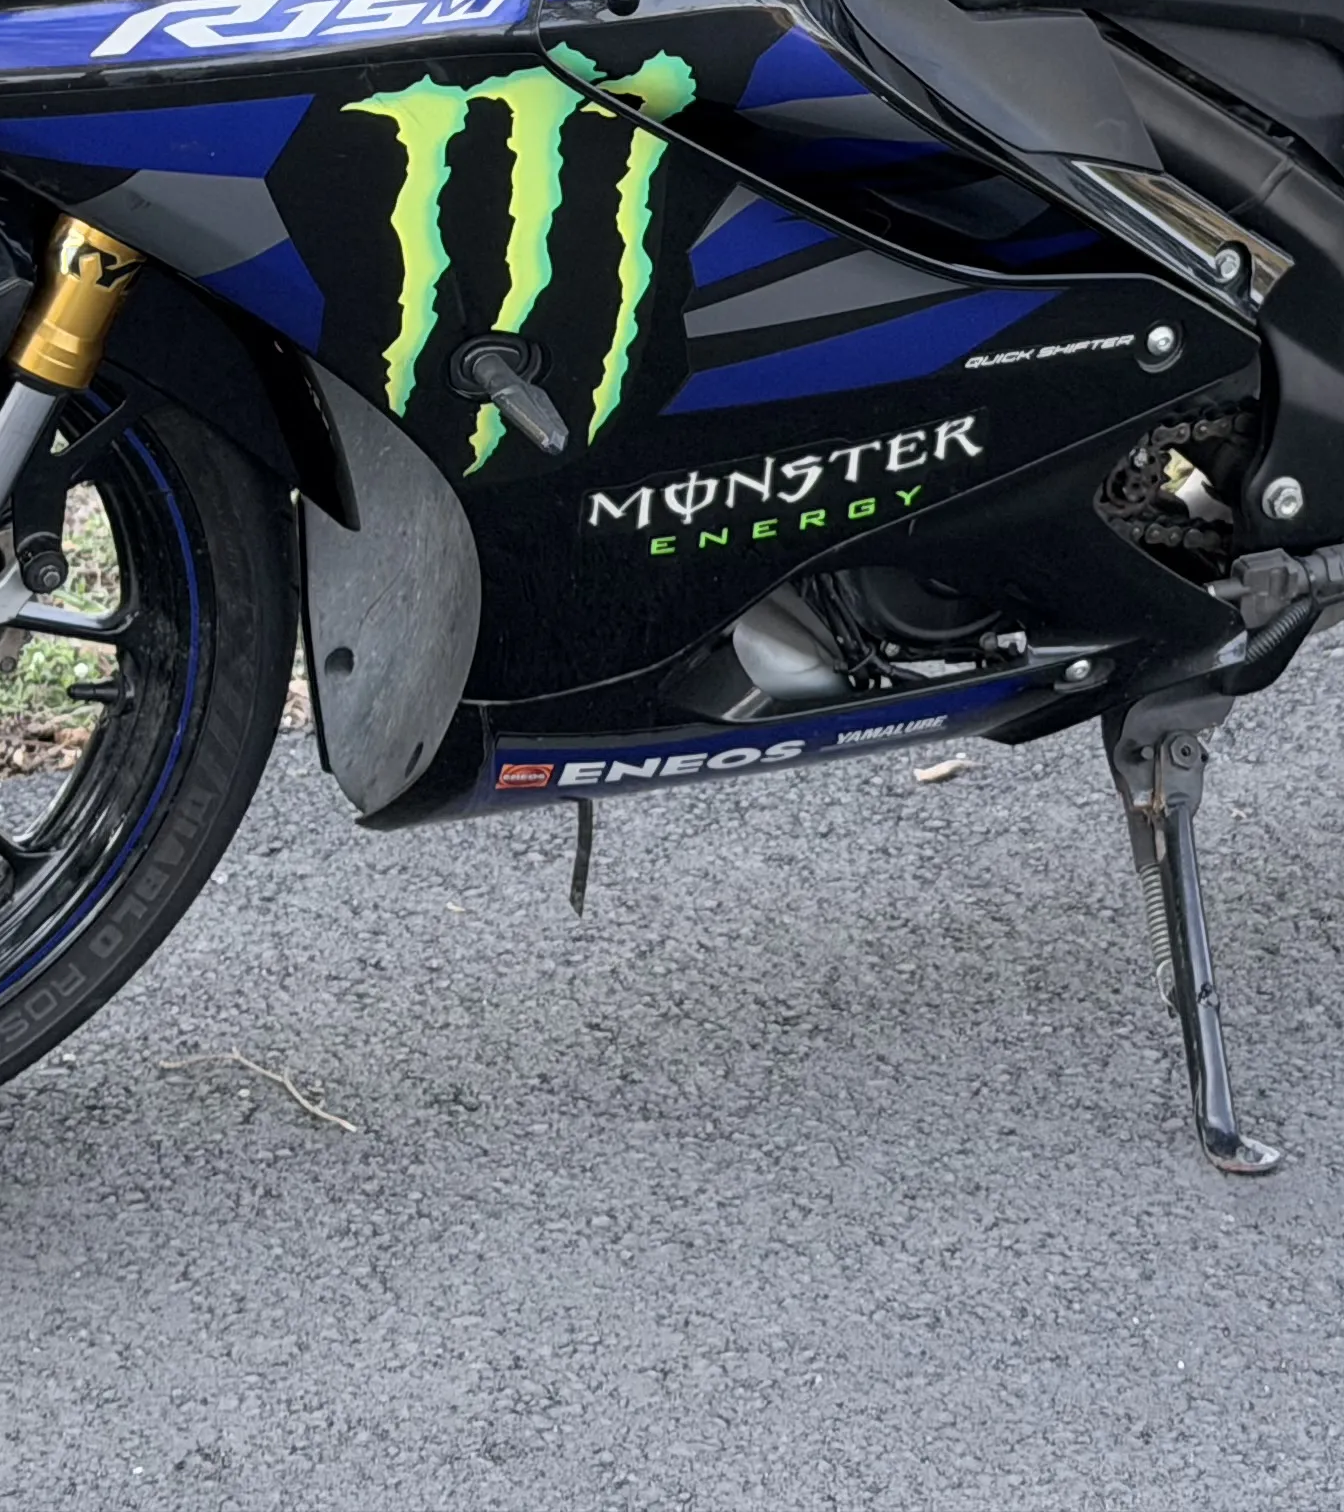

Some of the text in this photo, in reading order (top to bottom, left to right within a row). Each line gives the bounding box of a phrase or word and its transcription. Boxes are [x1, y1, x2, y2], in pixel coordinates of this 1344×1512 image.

[964, 333, 1136, 370] QUICK SHIFTER
[587, 414, 985, 530] MONSTER
[650, 484, 923, 556] ENERGY
[557, 739, 807, 787] ENEOS
